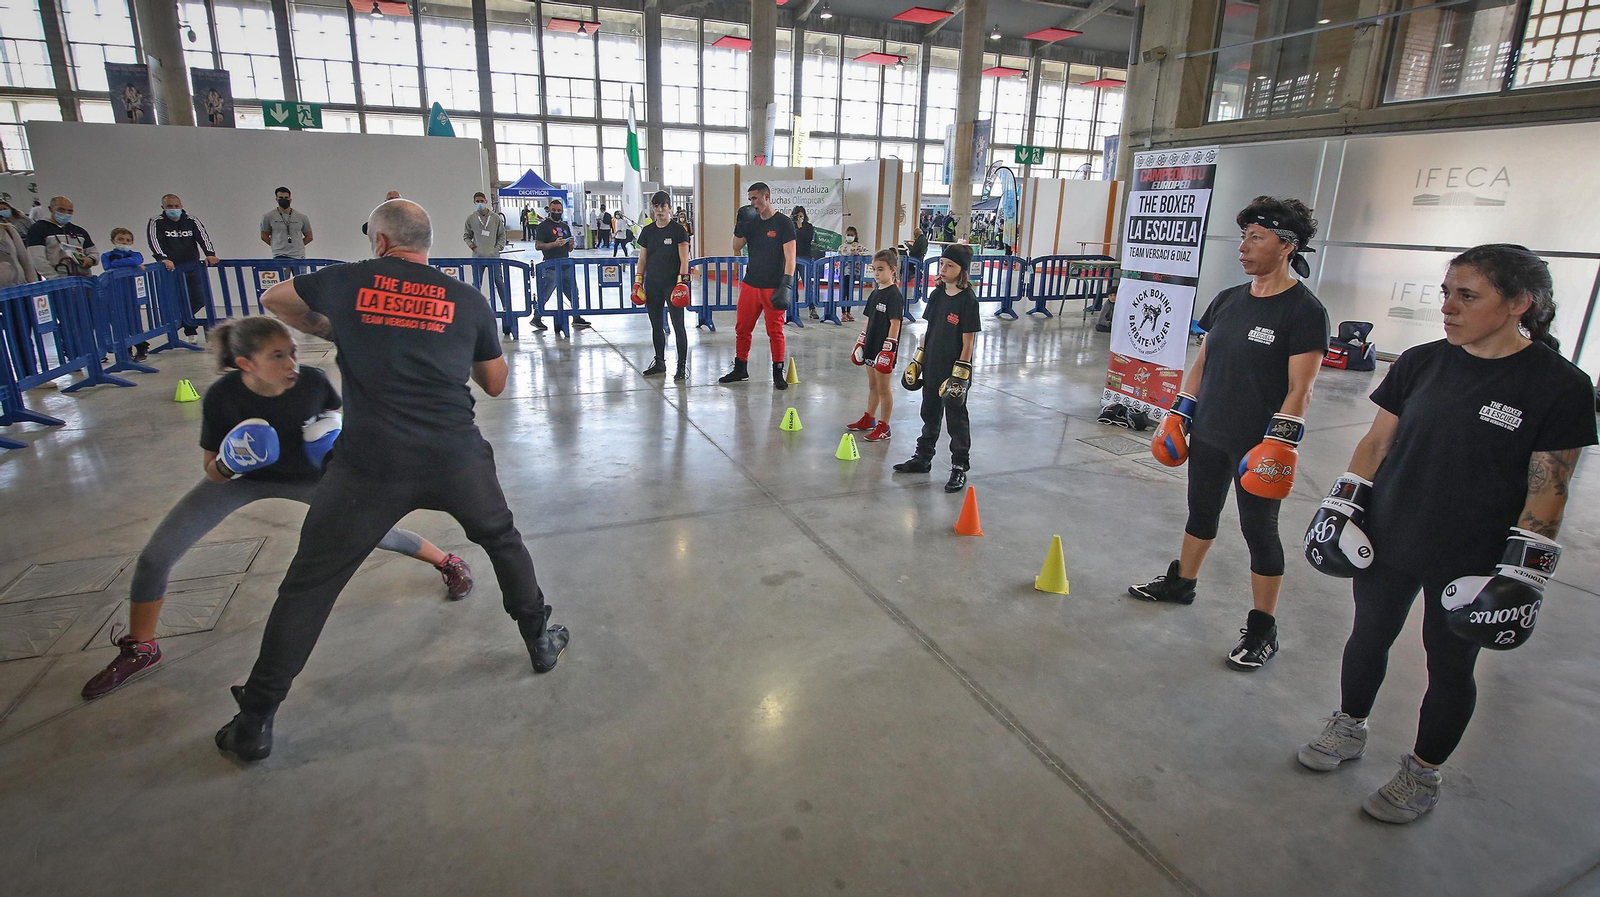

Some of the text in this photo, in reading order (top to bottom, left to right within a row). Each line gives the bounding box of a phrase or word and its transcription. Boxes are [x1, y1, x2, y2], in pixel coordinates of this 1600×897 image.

[1140, 166, 1206, 182] CAMPEONATO
[1415, 166, 1511, 188] IFECA
[797, 185, 829, 194] Andaluza
[1151, 180, 1191, 190] EUROPEO
[1139, 194, 1196, 213] THE BOXER
[165, 229, 193, 238] adidas
[1129, 219, 1198, 243] LA ESCUELA
[1129, 247, 1145, 257] TEAM
[1145, 248, 1169, 260] VERSACI
[1170, 251, 1175, 261] &
[373, 274, 446, 299] THE BOXER
[1390, 282, 1444, 304] IFE
[359, 291, 450, 320] LA ESCUELA
[1131, 288, 1172, 314] KICK BOXING
[361, 313, 384, 325] TEAM
[384, 317, 419, 329] VERSACI
[1481, 407, 1520, 427] LA ESCUELA
[1490, 400, 1523, 417] THE BOXER
[1513, 568, 1545, 585] STOOGES
[1469, 600, 1541, 629] Bronx
[1495, 629, 1516, 644] El
